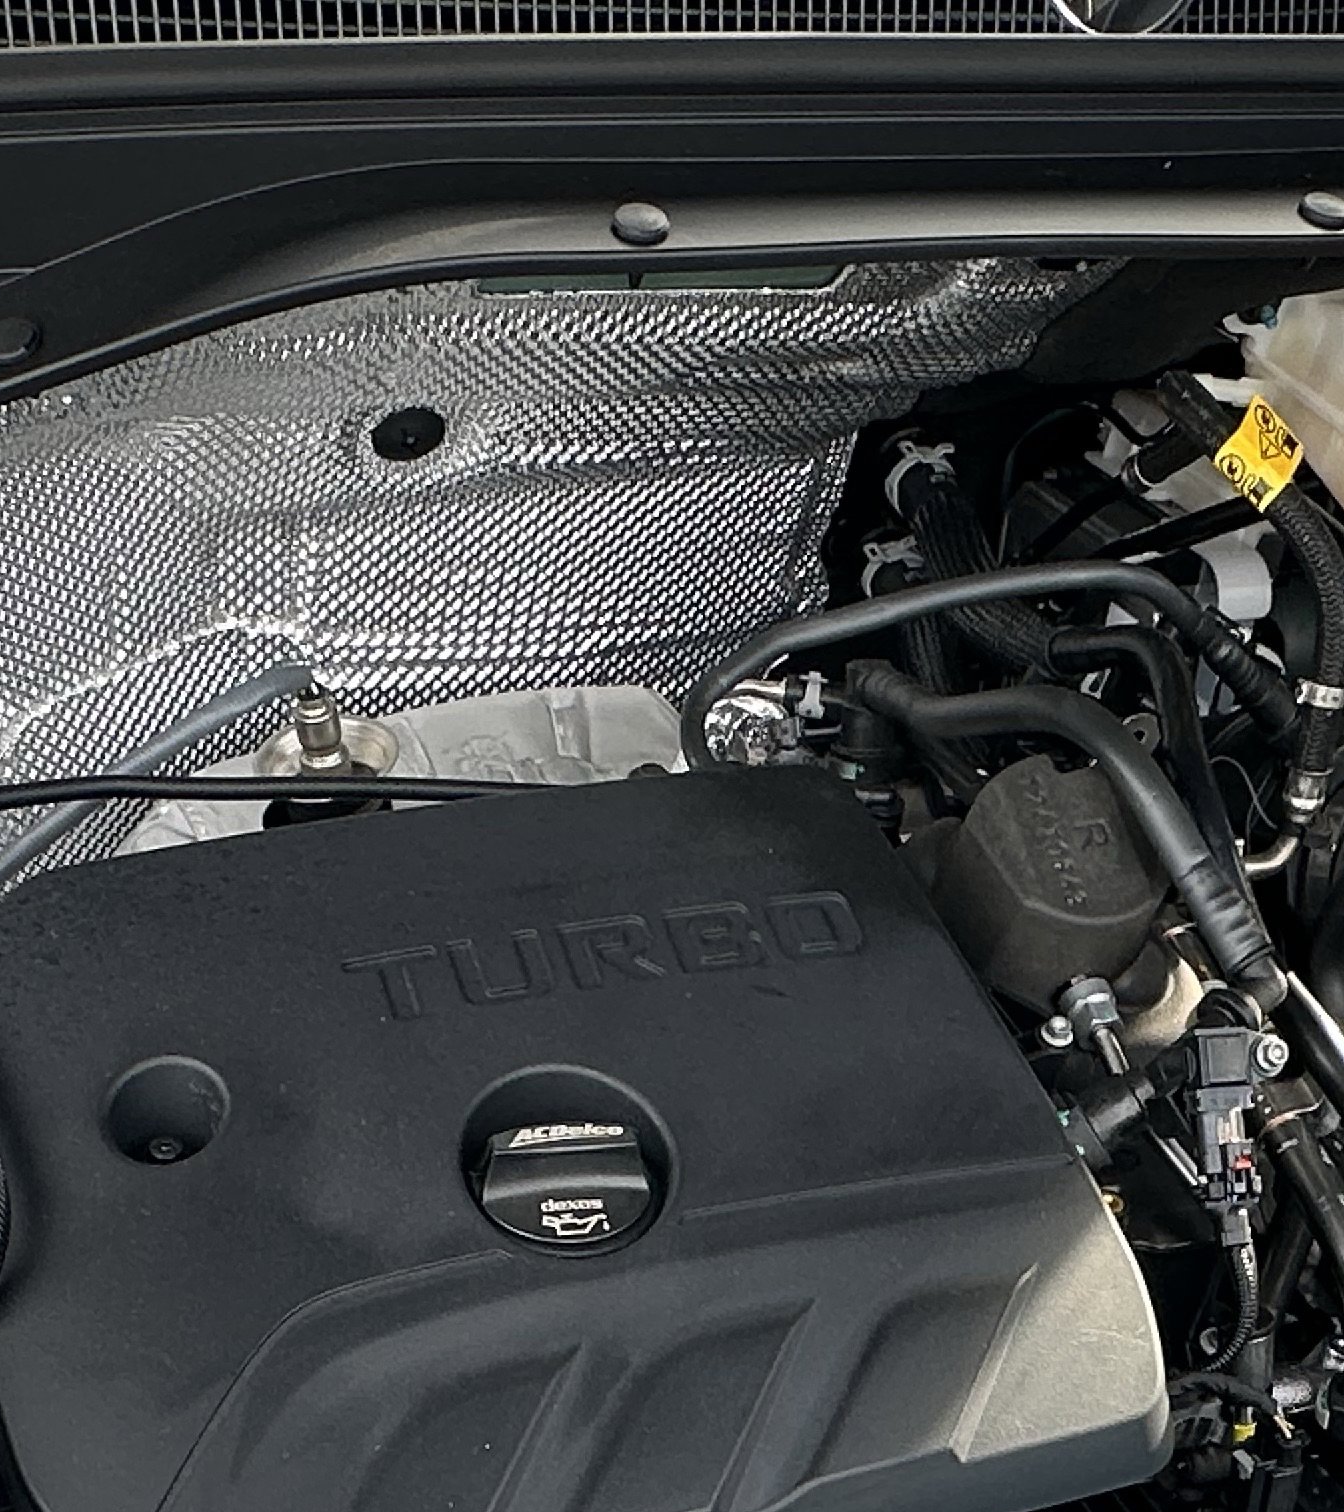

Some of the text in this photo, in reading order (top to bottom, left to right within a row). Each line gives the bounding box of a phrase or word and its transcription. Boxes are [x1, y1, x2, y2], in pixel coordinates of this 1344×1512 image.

[342, 890, 862, 1021] TURBO
[510, 1122, 624, 1146] ACDelco
[540, 1198, 604, 1212] dexos
